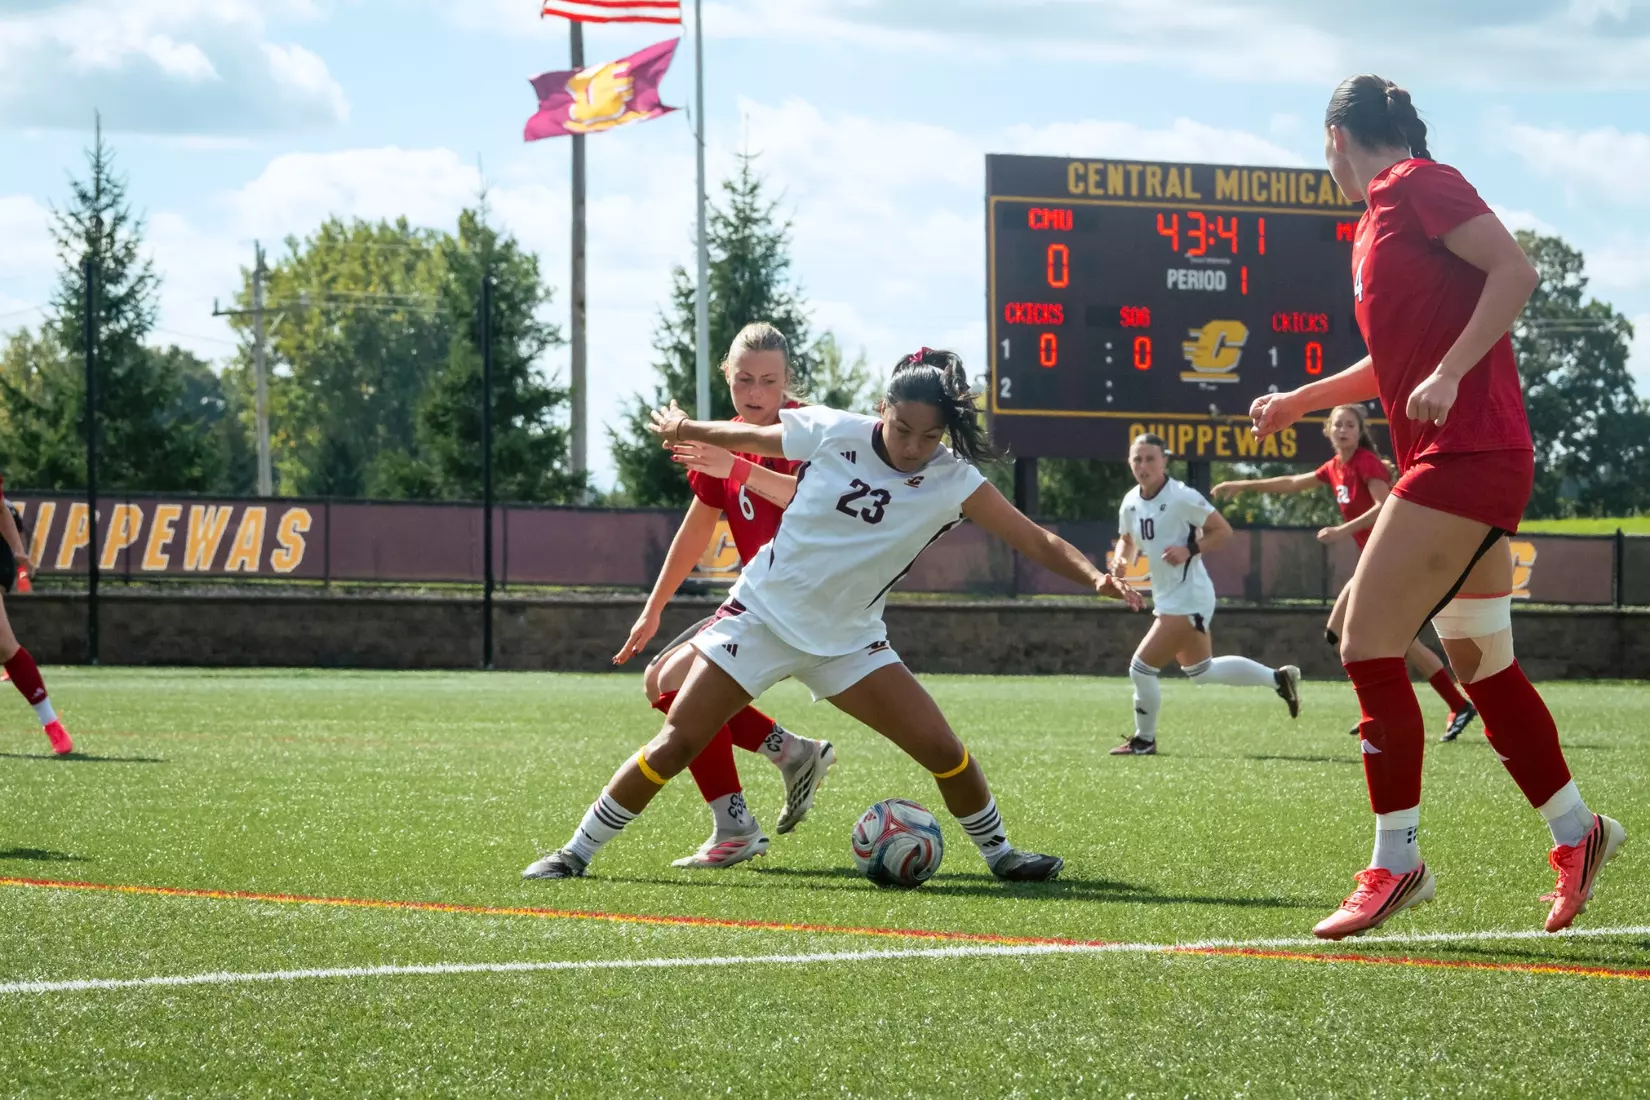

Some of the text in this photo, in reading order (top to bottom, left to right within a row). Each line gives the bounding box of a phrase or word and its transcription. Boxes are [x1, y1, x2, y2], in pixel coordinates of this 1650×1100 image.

[1067, 162, 1202, 199] CENTRAL
[1028, 208, 1073, 231] CMU
[1156, 211, 1265, 256] 43:41
[1047, 243, 1069, 289] 0
[1167, 265, 1248, 296] PERIOD 1
[1001, 332, 1152, 370] 1 0 0
[1268, 341, 1323, 375] 1 0
[1001, 377, 1012, 398] 2
[739, 485, 755, 521] 6
[836, 478, 892, 525] 23
[11, 501, 312, 572] IPPEWAS
[1140, 518, 1154, 540] 10
